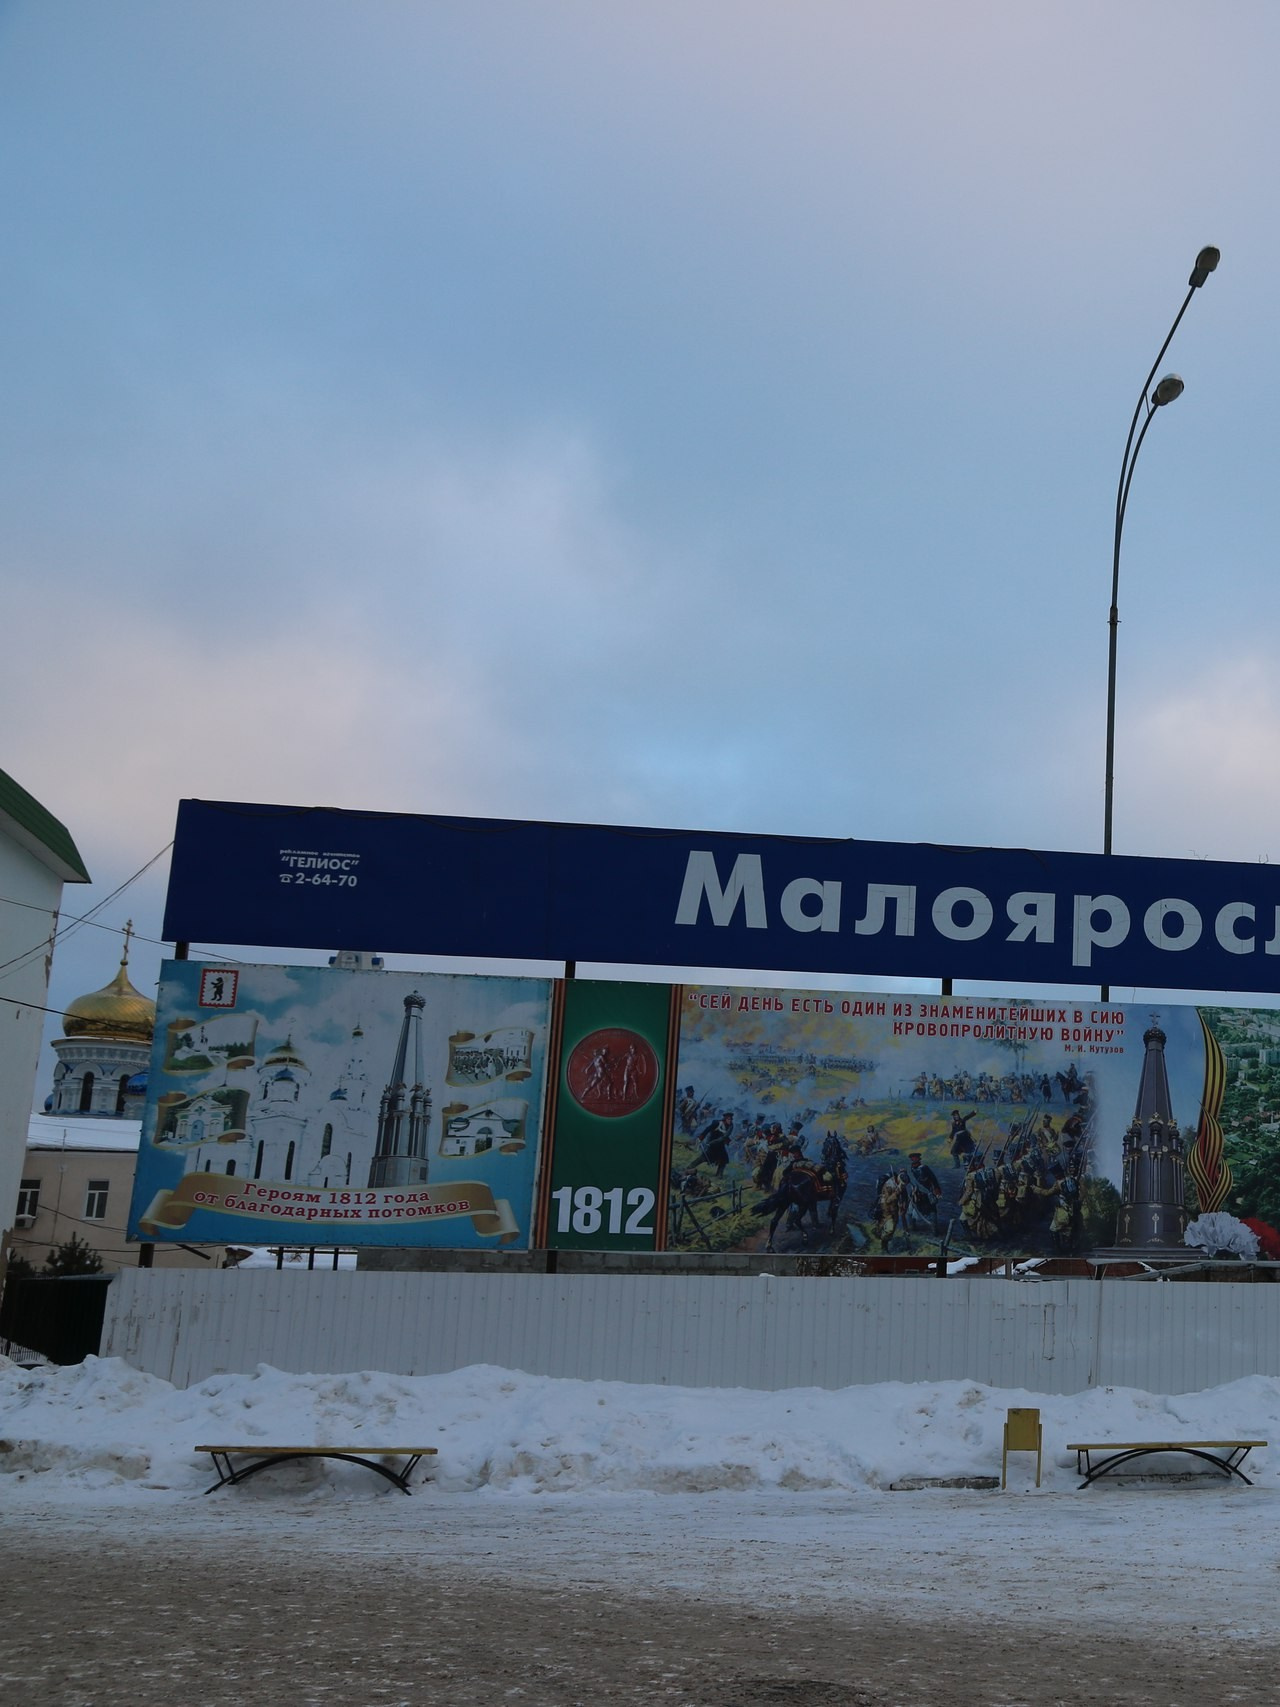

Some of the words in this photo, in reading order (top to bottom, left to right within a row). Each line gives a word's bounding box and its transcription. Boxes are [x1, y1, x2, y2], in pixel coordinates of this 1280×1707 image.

[295, 872, 358, 887] 2-64-70
[688, 992, 732, 1010] “СЕЙ
[738, 994, 785, 1014] ДЕНЬ
[791, 997, 833, 1015] ЕСТЬ
[841, 1000, 886, 1018] ОДИН
[892, 1001, 913, 1018] ИЗ
[919, 1002, 1067, 1024] ЗНАМЕНИТЕЙШИХ
[1073, 1008, 1084, 1023] В
[1090, 1009, 1125, 1026] СИЮ
[893, 1022, 1054, 1042] КРОВОПРОЛИТНУЮ
[1060, 1025, 1125, 1043] ВОЙНУ”
[1064, 1045, 1075, 1053] М.
[1089, 1045, 1125, 1056] Кутузов
[243, 1184, 320, 1204] Героям
[329, 1192, 376, 1204] 1812
[383, 1192, 430, 1204] года
[194, 1192, 218, 1204] от
[225, 1196, 361, 1220] благодарных
[368, 1200, 469, 1219] потомков
[552, 1186, 656, 1236] 1812
